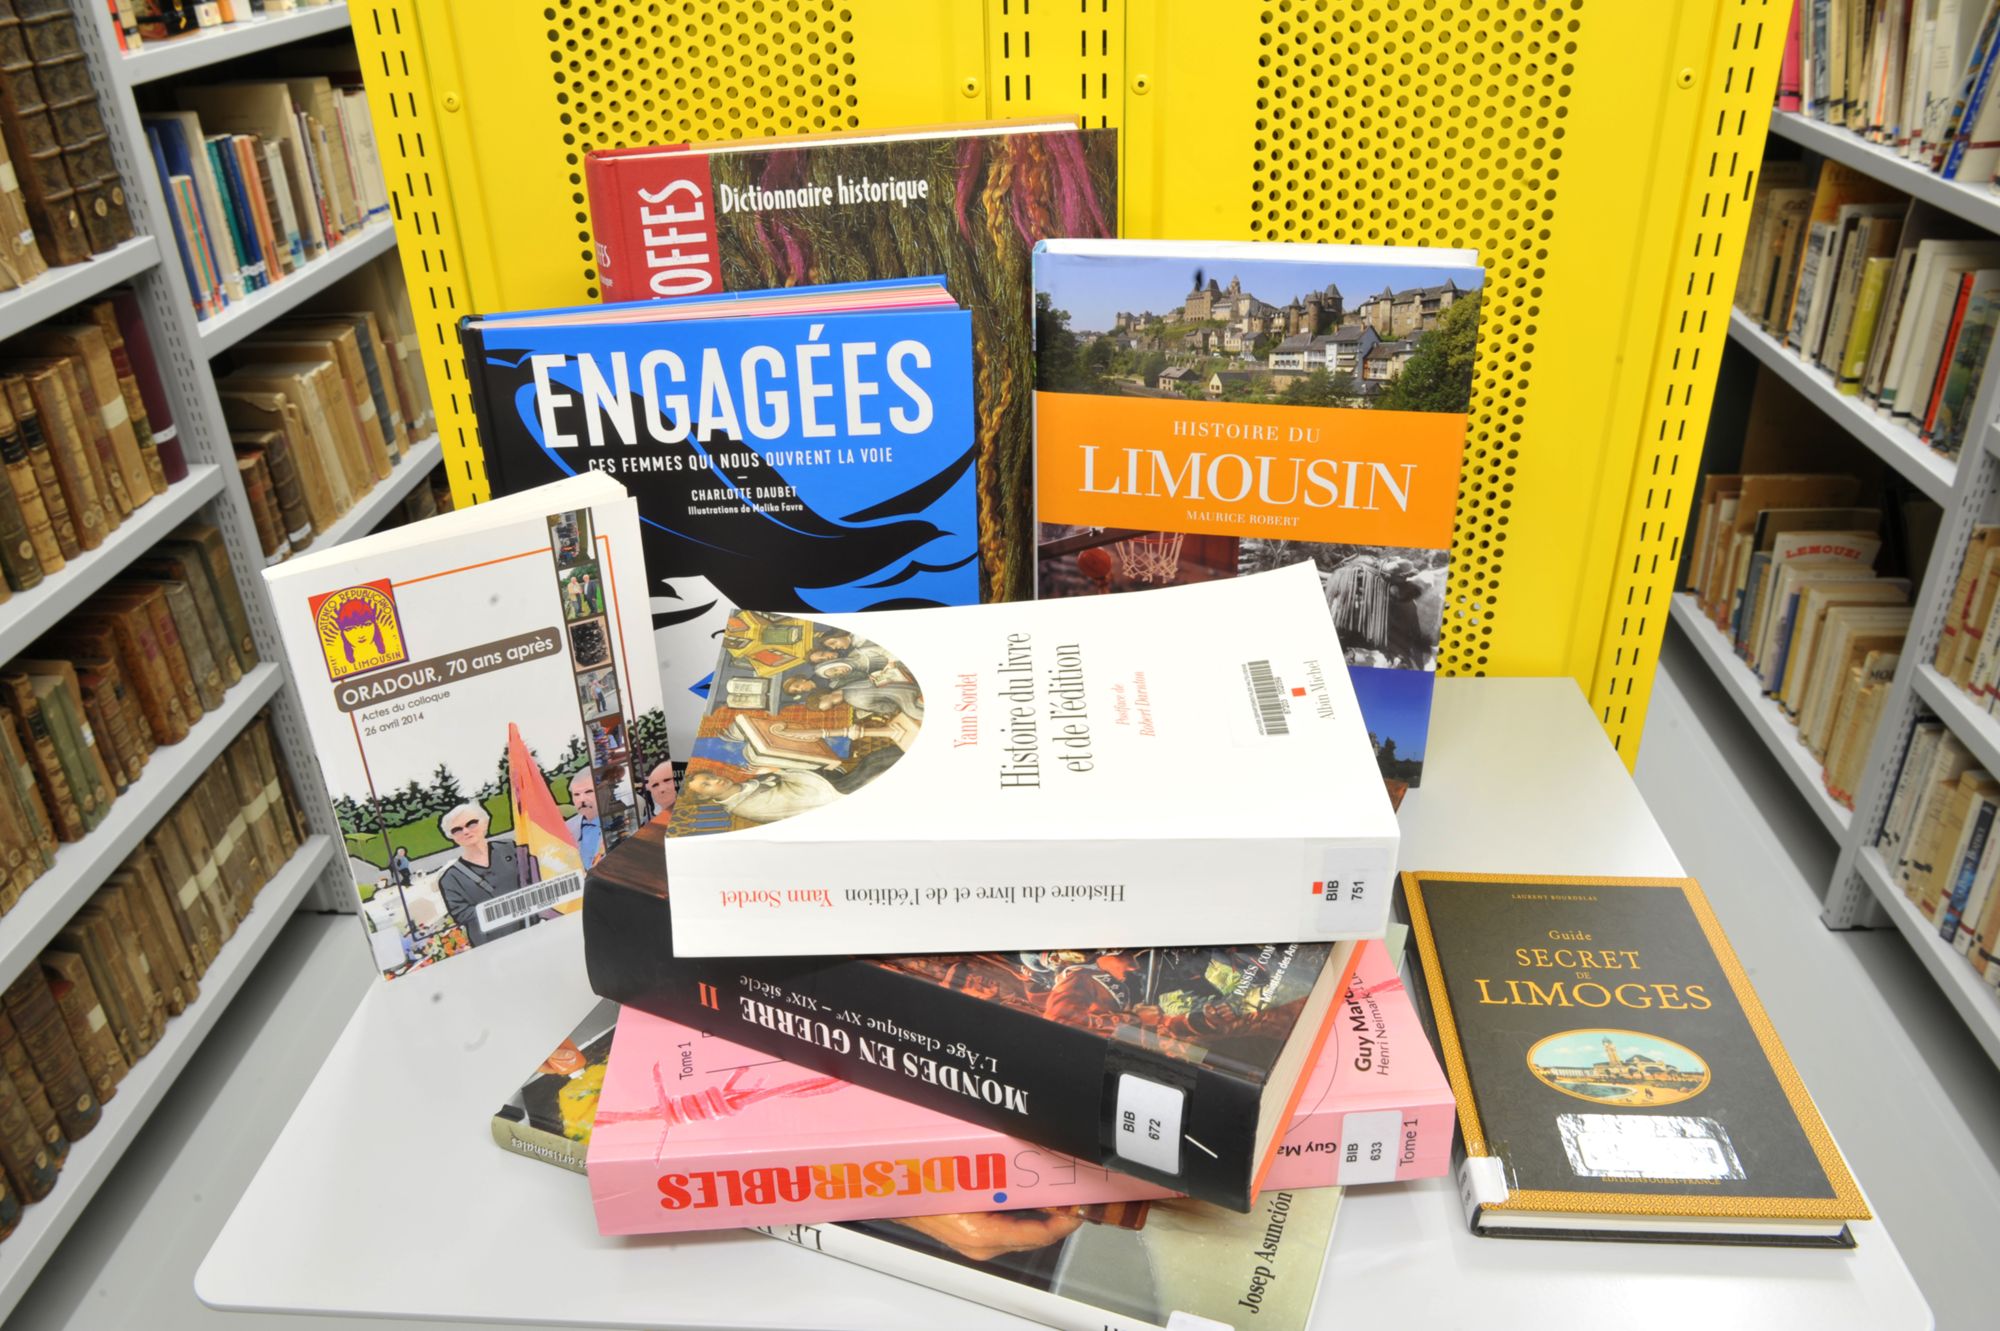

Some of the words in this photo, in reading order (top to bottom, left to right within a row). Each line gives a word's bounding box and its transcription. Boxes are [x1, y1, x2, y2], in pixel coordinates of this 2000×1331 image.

[720, 182, 833, 214] Dictionnaire
[837, 175, 929, 208] historique
[637, 179, 713, 300] OFFES
[530, 324, 935, 449] ENGAGÉES
[1173, 421, 1279, 441] HISTOIRE
[1289, 427, 1321, 443] DU
[589, 458, 616, 474] CES
[622, 455, 683, 473] FEMMES
[689, 454, 714, 471] QUI
[721, 452, 760, 469] NOUS
[766, 450, 832, 467] OUVRENT
[838, 449, 854, 465] LA
[860, 447, 893, 463] VOIE
[1078, 445, 1417, 512] LIMOUSIN
[691, 487, 752, 502] CHARLOTTE
[756, 486, 797, 499] DAUBET
[688, 503, 738, 516] Illustrations
[740, 504, 751, 514] de
[752, 502, 779, 514] Malika
[782, 502, 803, 512] Favre
[1187, 510, 1245, 524] MAURICE
[1249, 514, 1300, 527] ROBERT
[320, 600, 337, 631] ATENEO
[333, 665, 348, 676] DU
[353, 651, 401, 670] LIMOUSIN
[997, 632, 1032, 674] livre
[342, 667, 442, 706] ORADOUR,
[446, 658, 468, 677] 70
[472, 650, 502, 671] ans
[505, 636, 553, 661] après
[1048, 643, 1088, 721] l'édition
[1303, 660, 1328, 692] Michel
[954, 673, 978, 712] Sordet
[998, 677, 1035, 703] du
[361, 707, 390, 723] Actes
[392, 703, 406, 713] du
[408, 689, 451, 710] colloque
[1315, 693, 1336, 721] Albin
[364, 726, 377, 737] 26
[379, 719, 400, 733] avril
[402, 711, 424, 726] 2014
[954, 716, 978, 748] Yann
[1052, 723, 1092, 749] de
[1000, 706, 1041, 790] Histoire
[1057, 752, 1094, 773] et
[720, 890, 782, 908] Sordet
[787, 888, 834, 907] Yann
[845, 887, 919, 906] l'édition
[925, 887, 948, 905] de
[952, 887, 971, 900] et
[976, 886, 1015, 904] livre
[1021, 886, 1046, 903] du
[1051, 885, 1126, 903] Histoire
[1326, 880, 1339, 901] BIB
[1351, 881, 1365, 901] 751
[1548, 929, 1592, 941] Guide
[1279, 958, 1291, 973] des
[1515, 948, 1641, 969] SECRET
[739, 974, 783, 998] siècle
[1575, 971, 1592, 980] DE
[698, 982, 720, 1011] II
[1474, 979, 1713, 1010] LIMOGES
[739, 996, 851, 1055] GUERRE
[1361, 992, 1388, 1039] Neimark
[678, 1041, 692, 1049] 1
[866, 1016, 941, 1052] classique
[679, 1050, 693, 1081] Tome
[859, 1036, 897, 1072] EN
[946, 1043, 998, 1074] L'Âge
[1355, 1036, 1375, 1073] Guy
[1376, 1041, 1391, 1077] Henri
[902, 1051, 1029, 1116] MONDES
[1123, 1110, 1136, 1134] BIB
[1148, 1118, 1161, 1141] 672
[1404, 1118, 1418, 1127] 1
[511, 1137, 576, 1166] artisanales
[1305, 1141, 1338, 1154] Guy
[1346, 1143, 1359, 1163] BIB
[1370, 1141, 1383, 1161] 633
[1400, 1130, 1417, 1168] Tome
[1254, 1191, 1293, 1264] Asunción
[1238, 1265, 1276, 1315] Josep
